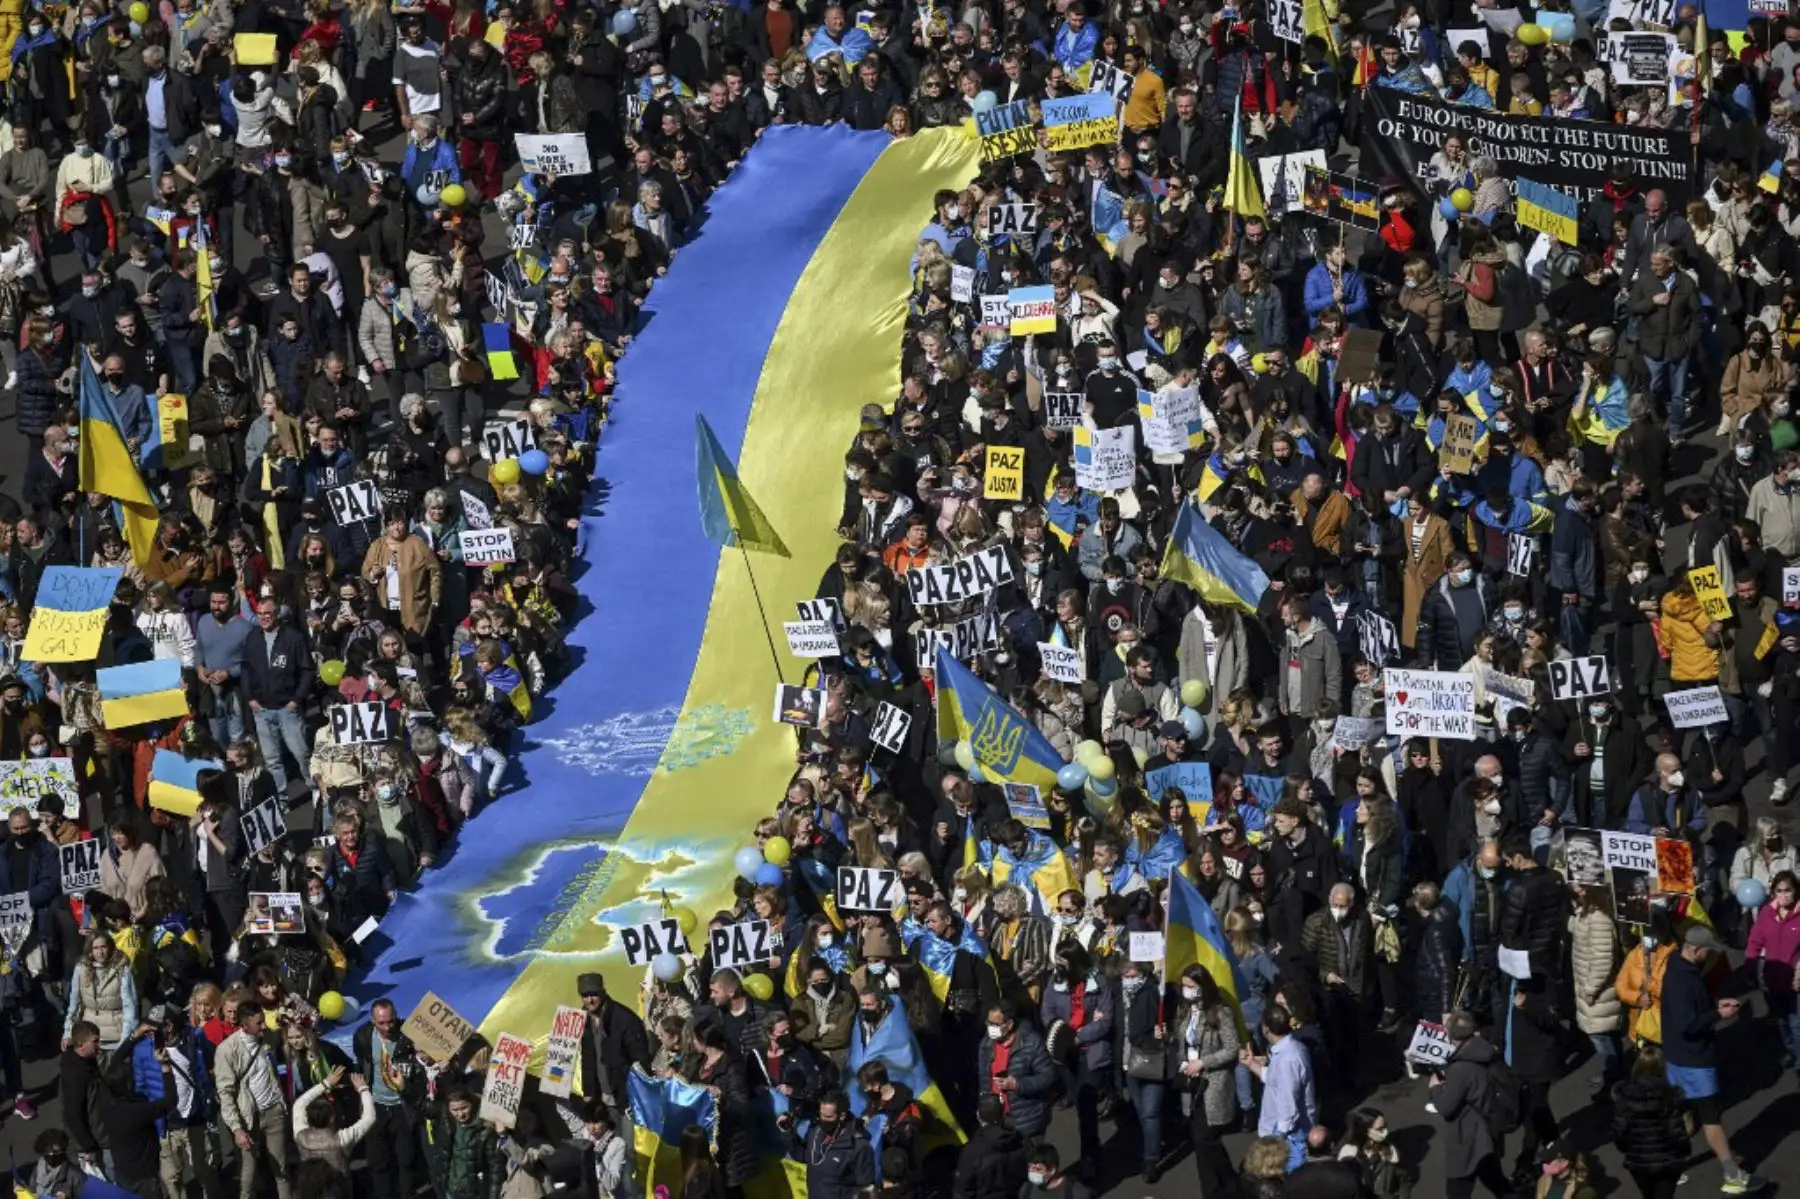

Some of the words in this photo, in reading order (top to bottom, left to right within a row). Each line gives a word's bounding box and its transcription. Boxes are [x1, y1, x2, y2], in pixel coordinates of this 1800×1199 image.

[1268, 0, 1303, 33] PAZ
[1598, 38, 1631, 62] PAZ
[1091, 61, 1134, 102] PAZ
[977, 101, 1030, 136] PUTIN
[542, 144, 558, 153] NO
[1377, 118, 1405, 139] OF
[1411, 124, 1447, 148] YOU
[1560, 150, 1608, 171] STOP
[1477, 117, 1550, 143] PROTECT
[1554, 126, 1590, 147] THE
[1592, 131, 1670, 156] FUTURE
[989, 205, 1035, 233] PAZ
[984, 301, 1009, 312] STO
[1047, 394, 1081, 417] PAZ
[486, 420, 535, 462] PAZ
[990, 452, 1020, 470] PAZ
[988, 476, 1017, 493] JUSTA
[330, 481, 377, 521] PAZ
[464, 534, 507, 547] STOP
[465, 550, 512, 562] PUTIN
[908, 567, 961, 603] PAZ
[955, 549, 1012, 597] PAZ
[1694, 572, 1719, 592] PAZ
[797, 598, 846, 634] PAZ
[40, 638, 80, 656] GAS
[956, 612, 999, 660] PAZ
[1043, 649, 1074, 663] STOP
[1045, 662, 1079, 678] PUTIN
[1550, 657, 1608, 698] PAZ
[1451, 681, 1473, 692] AND
[331, 702, 385, 742] PAZ
[873, 702, 911, 752] PAZ
[1395, 711, 1422, 729] STOP
[1423, 716, 1441, 732] THE
[243, 800, 285, 853] PAZ
[63, 841, 98, 875] PAZ
[1608, 838, 1653, 853] STOP
[1607, 854, 1656, 869] PUTIN
[64, 873, 100, 889] JUSTA
[839, 868, 895, 909] PAZ
[0, 900, 24, 911] OP
[0, 912, 27, 924] TIN
[621, 919, 686, 964] PAZ
[713, 921, 770, 966] PAZ
[429, 1002, 471, 1041] OTAN
[553, 1011, 586, 1040] NATO
[1421, 1026, 1448, 1042] TIN
[495, 1061, 522, 1087] ACT
[493, 1080, 518, 1096] STOP
